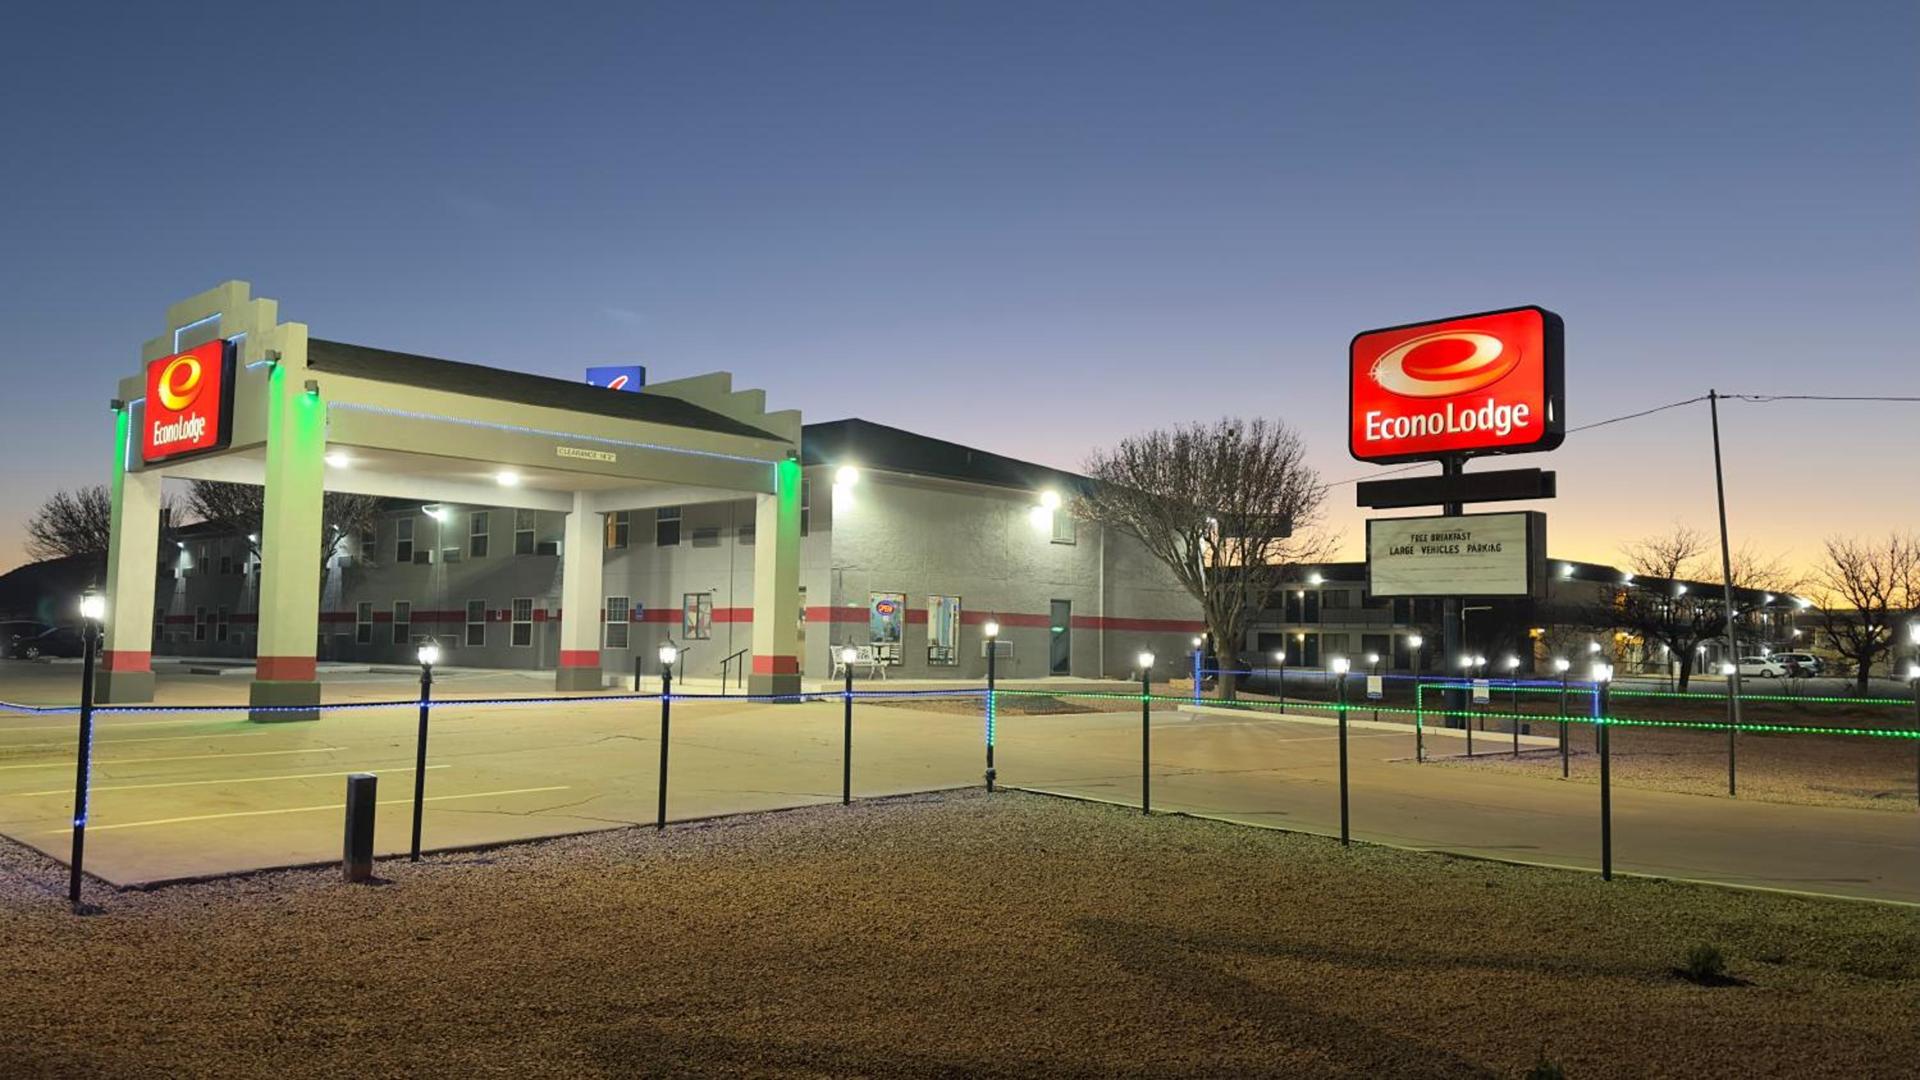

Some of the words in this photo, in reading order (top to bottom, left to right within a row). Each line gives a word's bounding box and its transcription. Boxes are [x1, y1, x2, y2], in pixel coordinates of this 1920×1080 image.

[153, 411, 206, 446] EconoLodge
[1366, 398, 1529, 441] EconoLodge
[1389, 546, 1414, 556] LARGE
[1421, 544, 1460, 555] VEHICLES
[1467, 543, 1502, 553] PARKING
[1410, 534, 1428, 543] FREE
[1430, 532, 1472, 542] BREAKFAST
